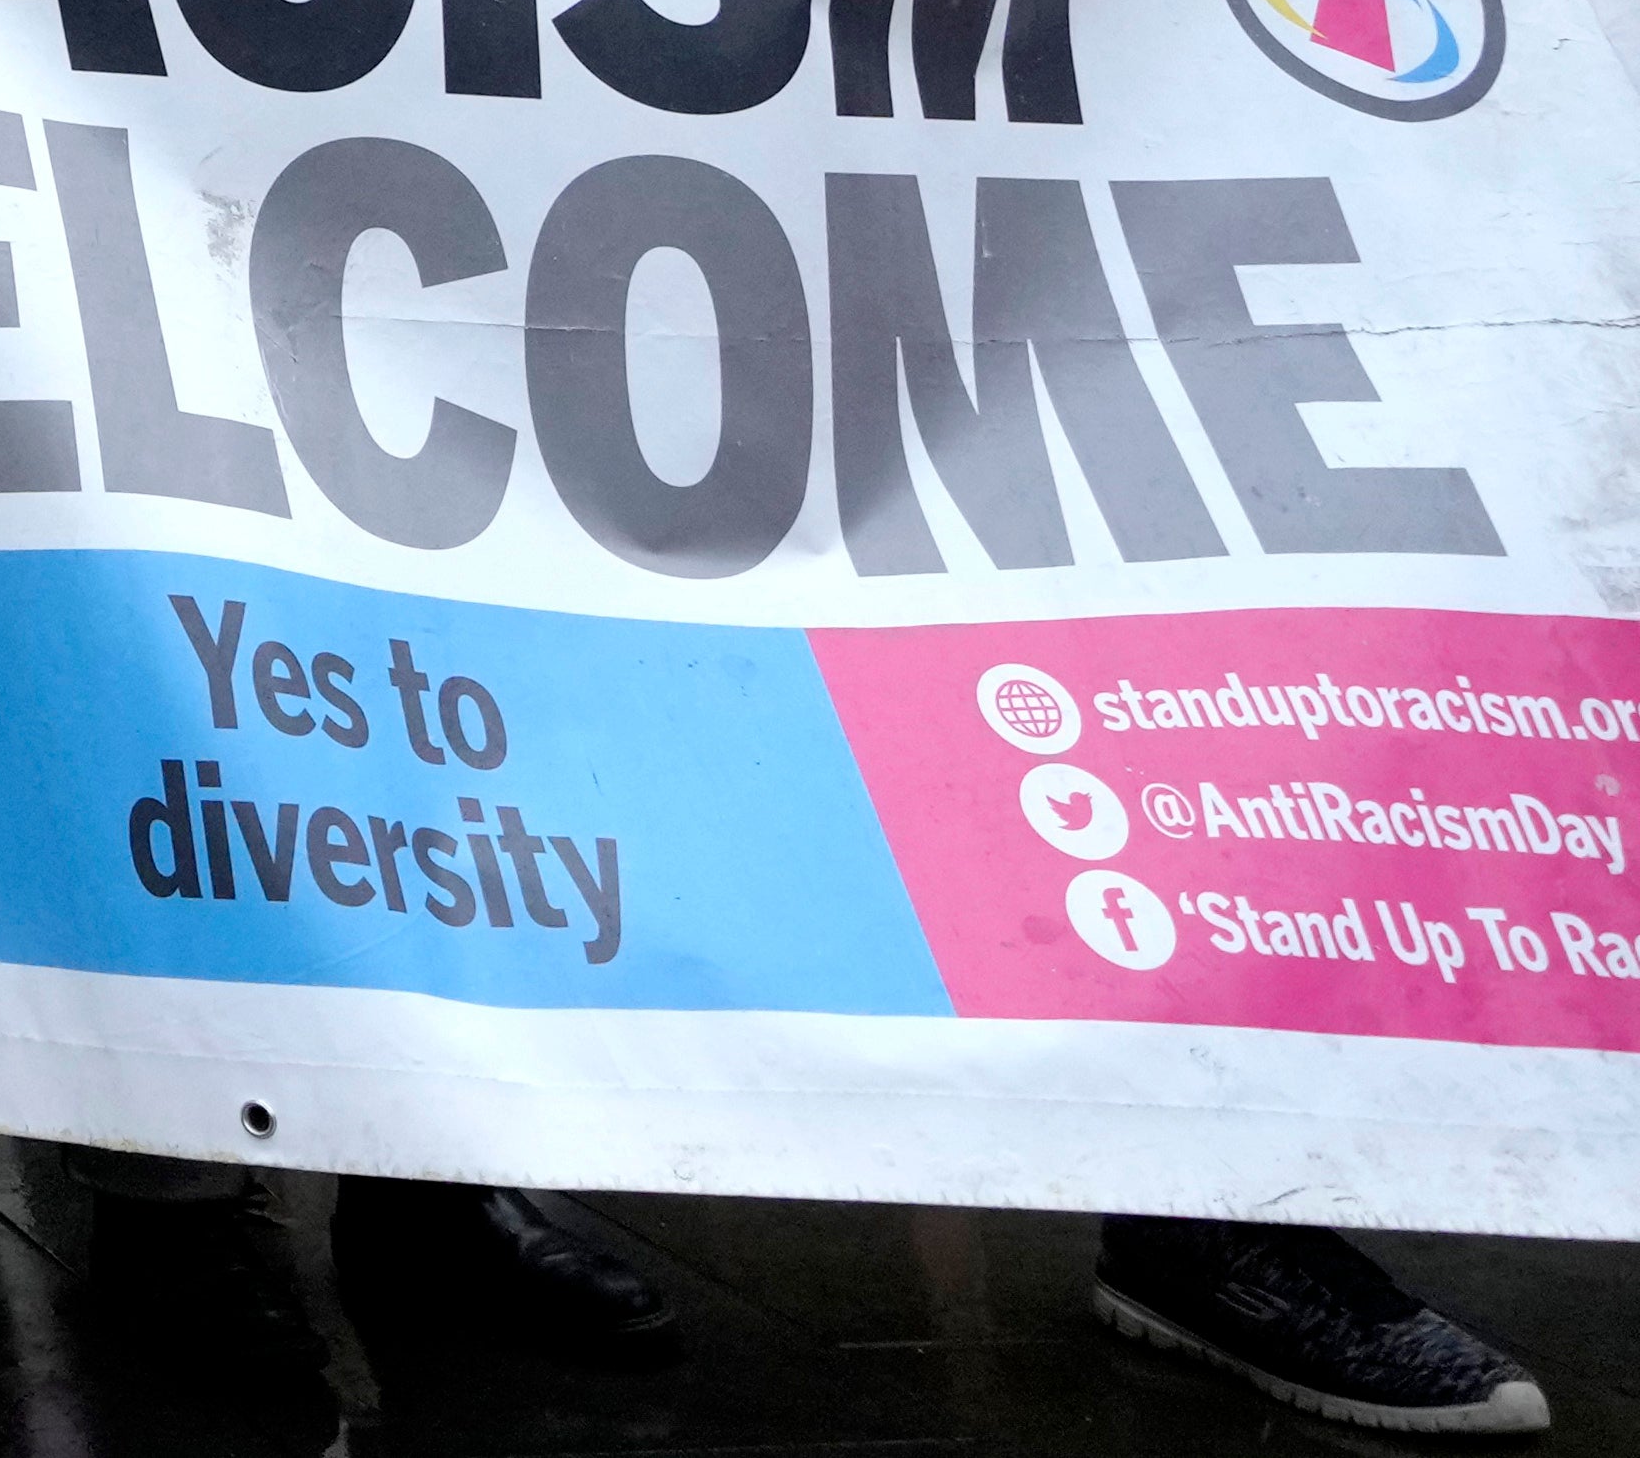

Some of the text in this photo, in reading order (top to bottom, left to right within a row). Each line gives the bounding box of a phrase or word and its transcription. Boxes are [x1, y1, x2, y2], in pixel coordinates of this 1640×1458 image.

[168, 595, 507, 770] Yes to
[128, 755, 620, 964] diversity
[1141, 782, 1624, 874] @AntiRacismDay
[1381, 900, 1464, 984] Up
[1465, 908, 1548, 972] To
